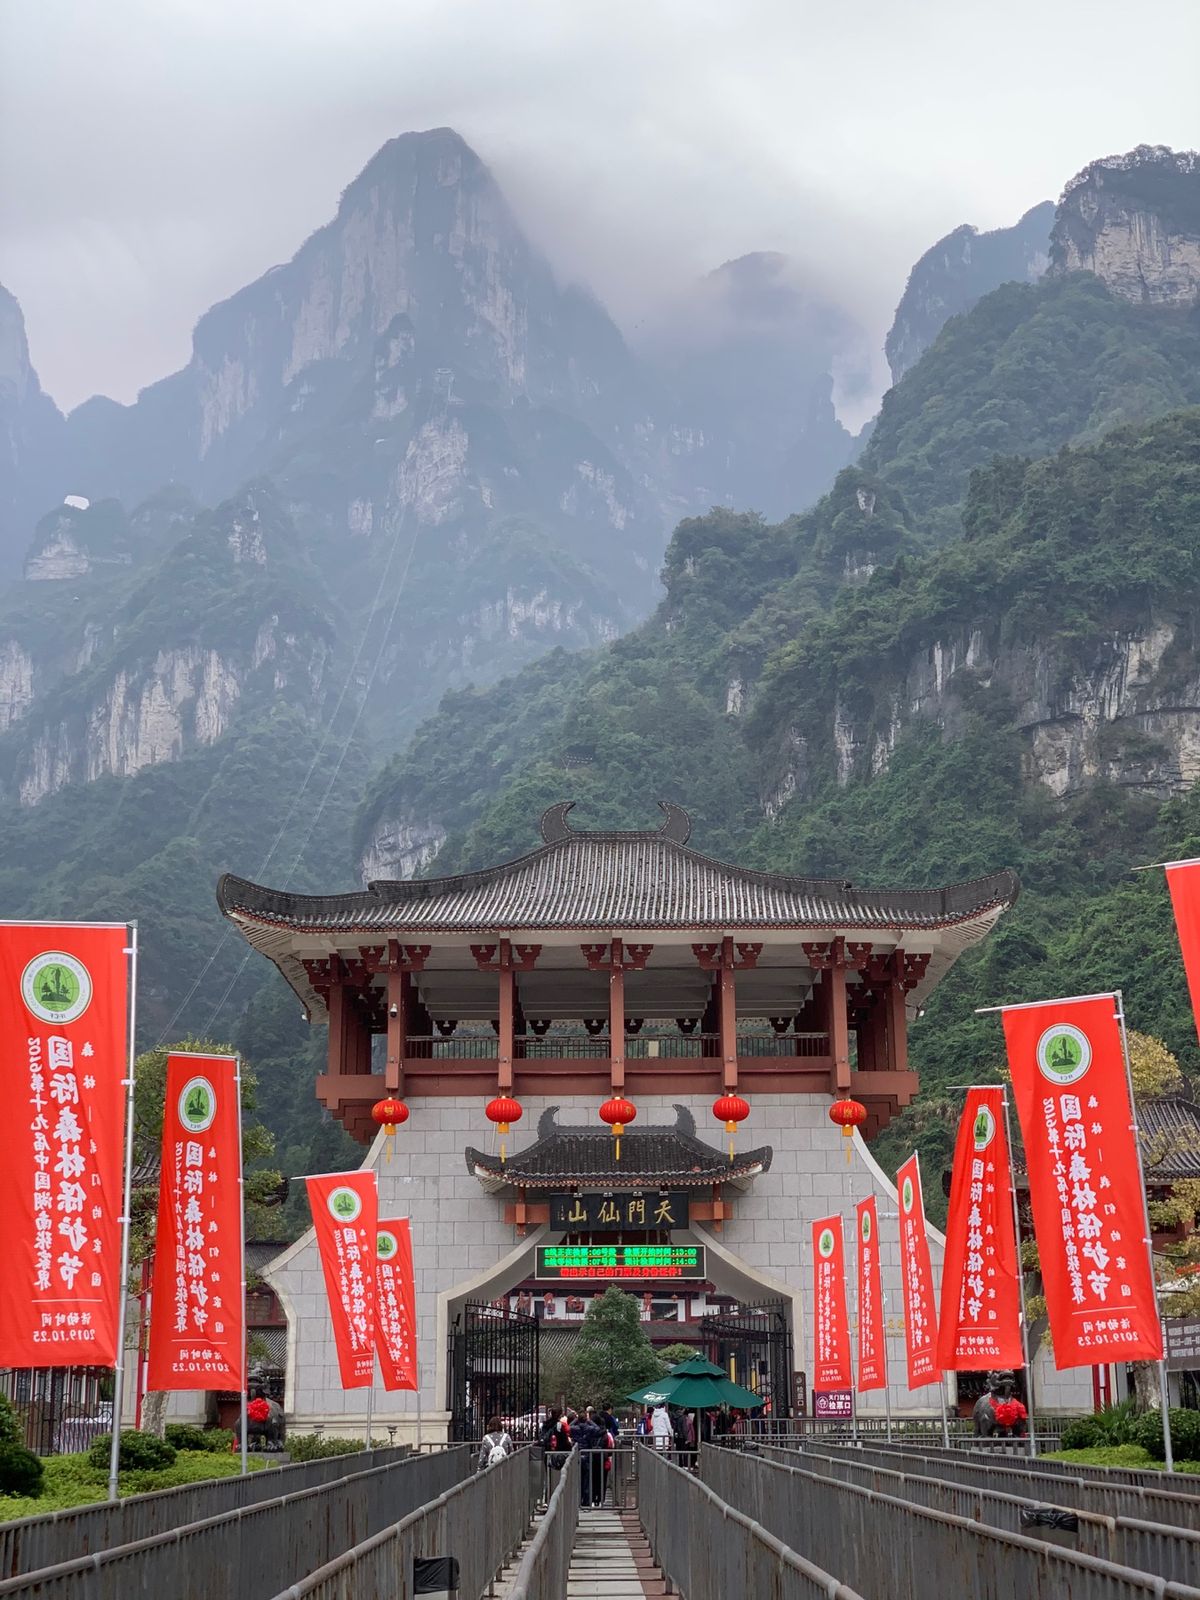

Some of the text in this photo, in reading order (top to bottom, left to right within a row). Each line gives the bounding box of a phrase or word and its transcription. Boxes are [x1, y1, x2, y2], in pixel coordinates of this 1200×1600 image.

[568, 1199, 676, 1225] 天門仙山
[829, 1401, 851, 1410] 检票口
